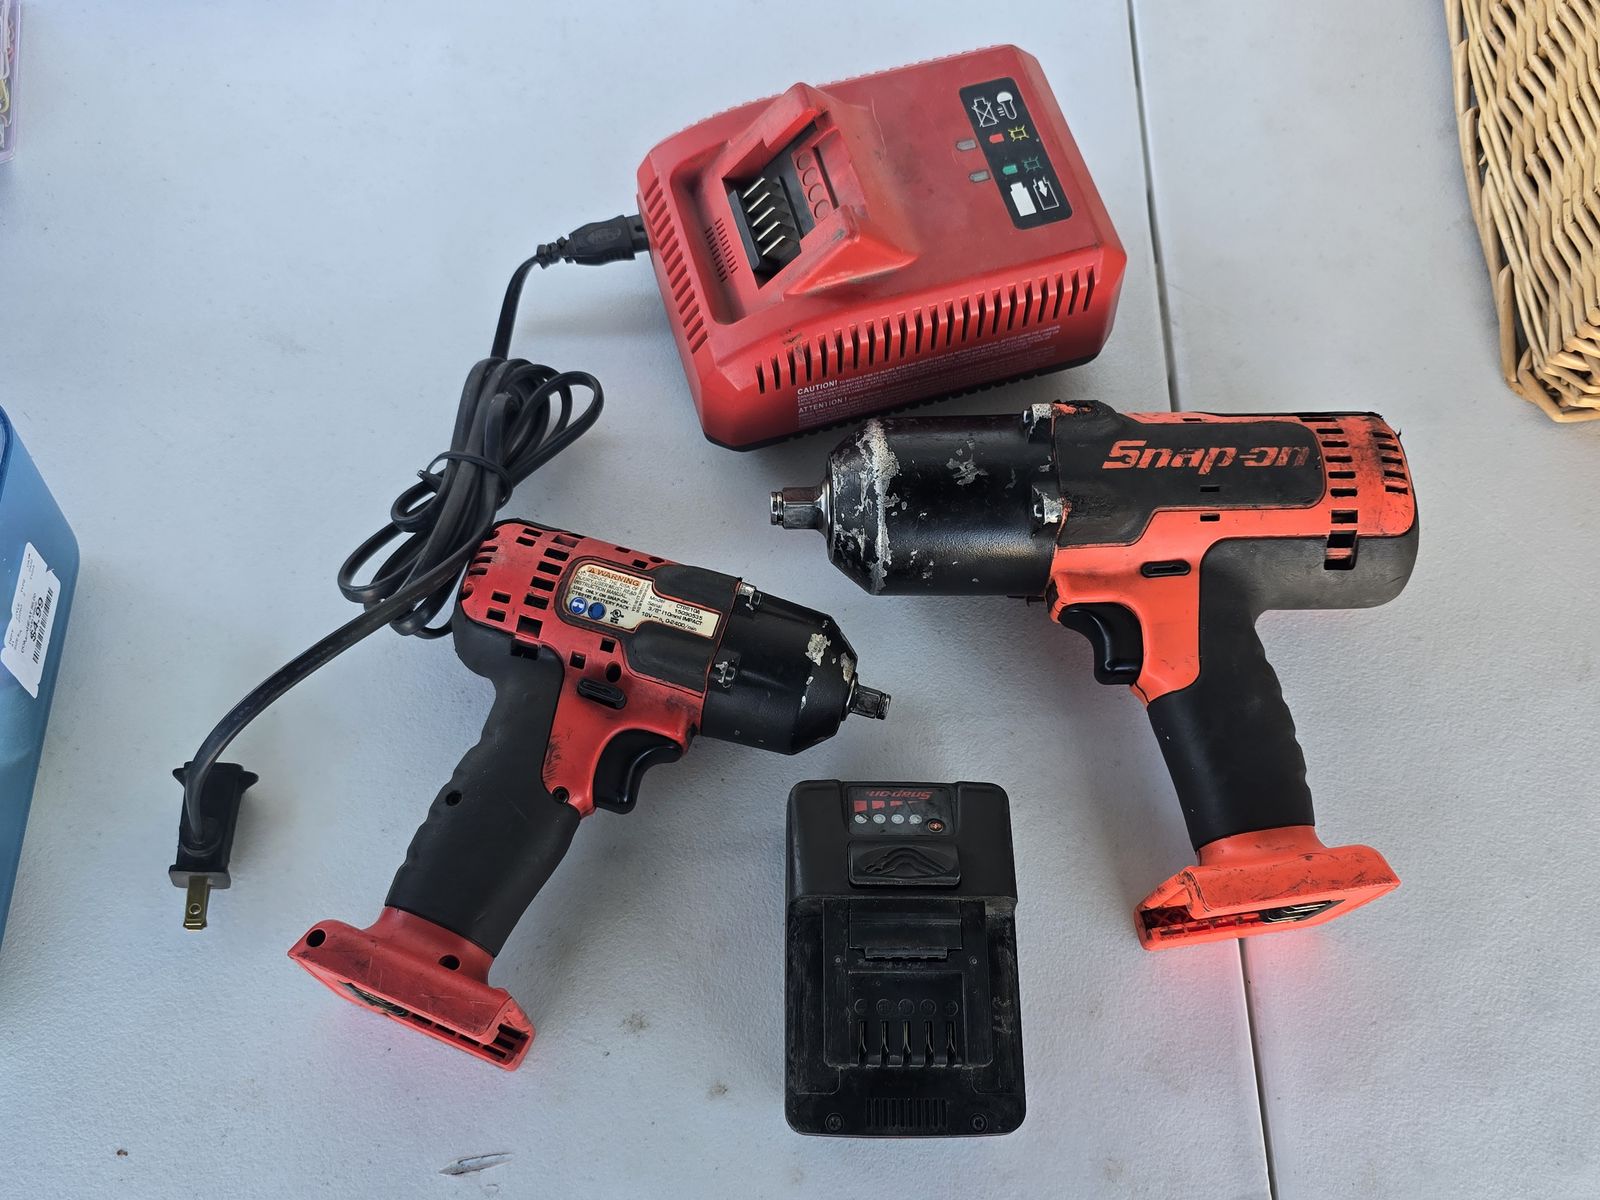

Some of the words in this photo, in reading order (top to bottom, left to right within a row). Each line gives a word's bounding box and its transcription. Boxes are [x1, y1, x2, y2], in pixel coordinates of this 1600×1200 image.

[797, 380, 838, 395] CAUTION!
[1102, 440, 1310, 475] Snap-on
[597, 569, 640, 587] WARNING
[593, 596, 615, 606] BATTERY
[647, 601, 662, 609] Serial
[649, 596, 665, 604] Model
[30, 597, 43, 642] $4.99
[682, 616, 703, 626] IMPACT
[868, 790, 933, 800] Snap-on
